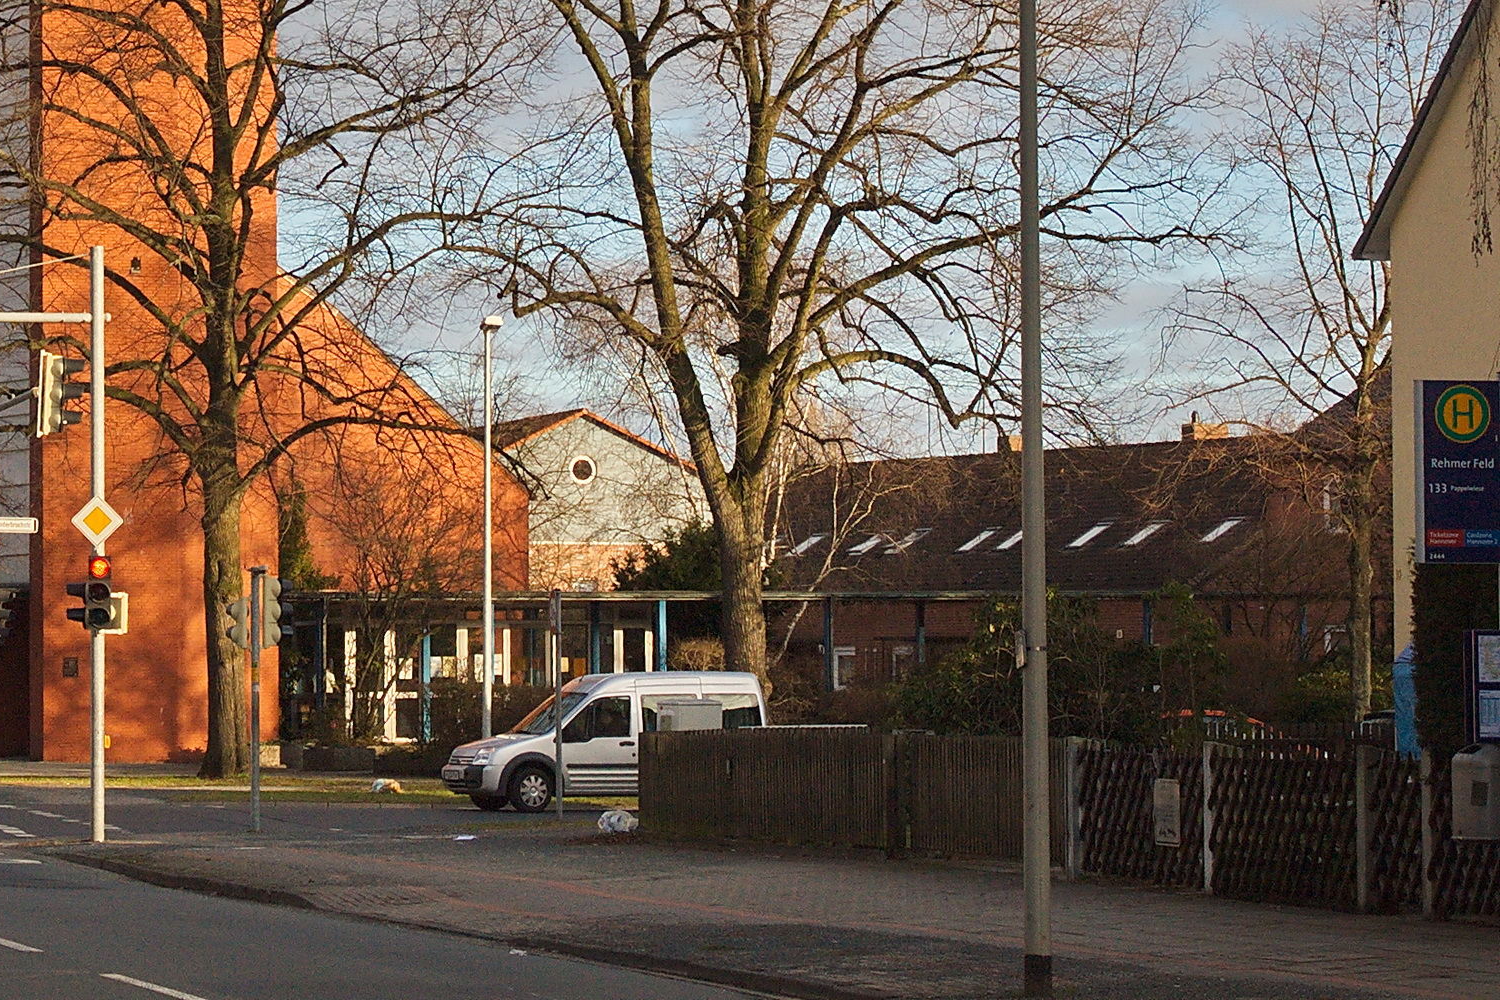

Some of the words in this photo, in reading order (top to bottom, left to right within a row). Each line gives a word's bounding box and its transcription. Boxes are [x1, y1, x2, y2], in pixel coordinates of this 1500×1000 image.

[1452, 399, 1474, 429] H
[1431, 458, 1471, 469] Rehmer
[1473, 457, 1495, 469] Feld
[1428, 483, 1448, 494] 133
